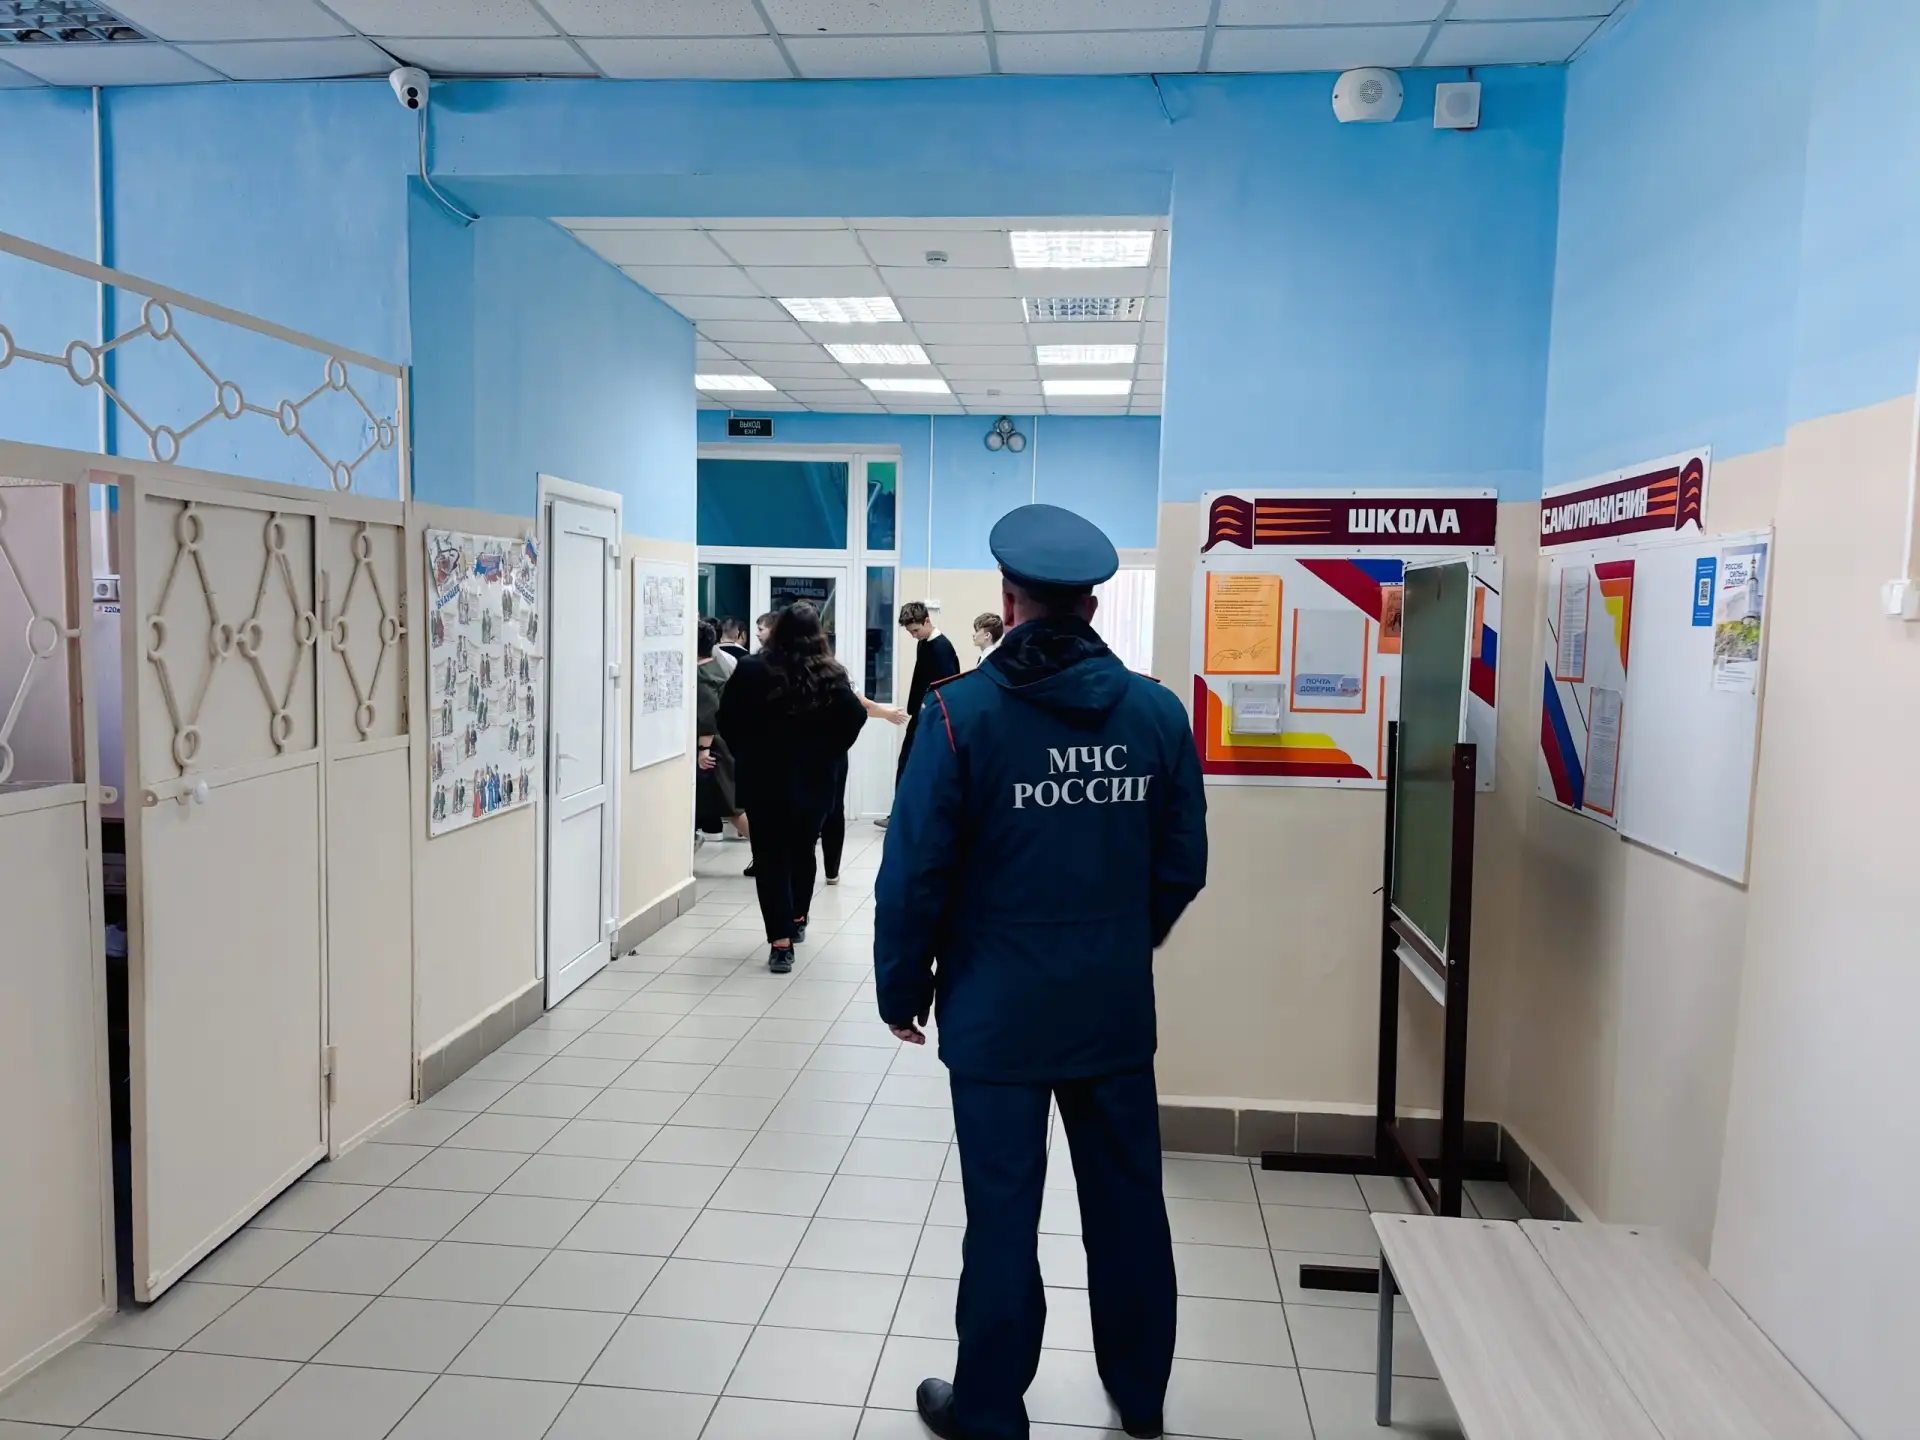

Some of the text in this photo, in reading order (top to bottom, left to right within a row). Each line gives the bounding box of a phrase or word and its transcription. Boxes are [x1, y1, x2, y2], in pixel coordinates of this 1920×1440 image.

[740, 420, 761, 429] ВЫХОД
[1348, 508, 1461, 534] ШКОЛА
[1541, 486, 1648, 535] САМОУПРАВЛЕНИЯ
[1300, 685, 1336, 693] ДОВЕРИЯ
[1047, 744, 1128, 774] МЧС
[1012, 774, 1154, 809] РОССИИ
